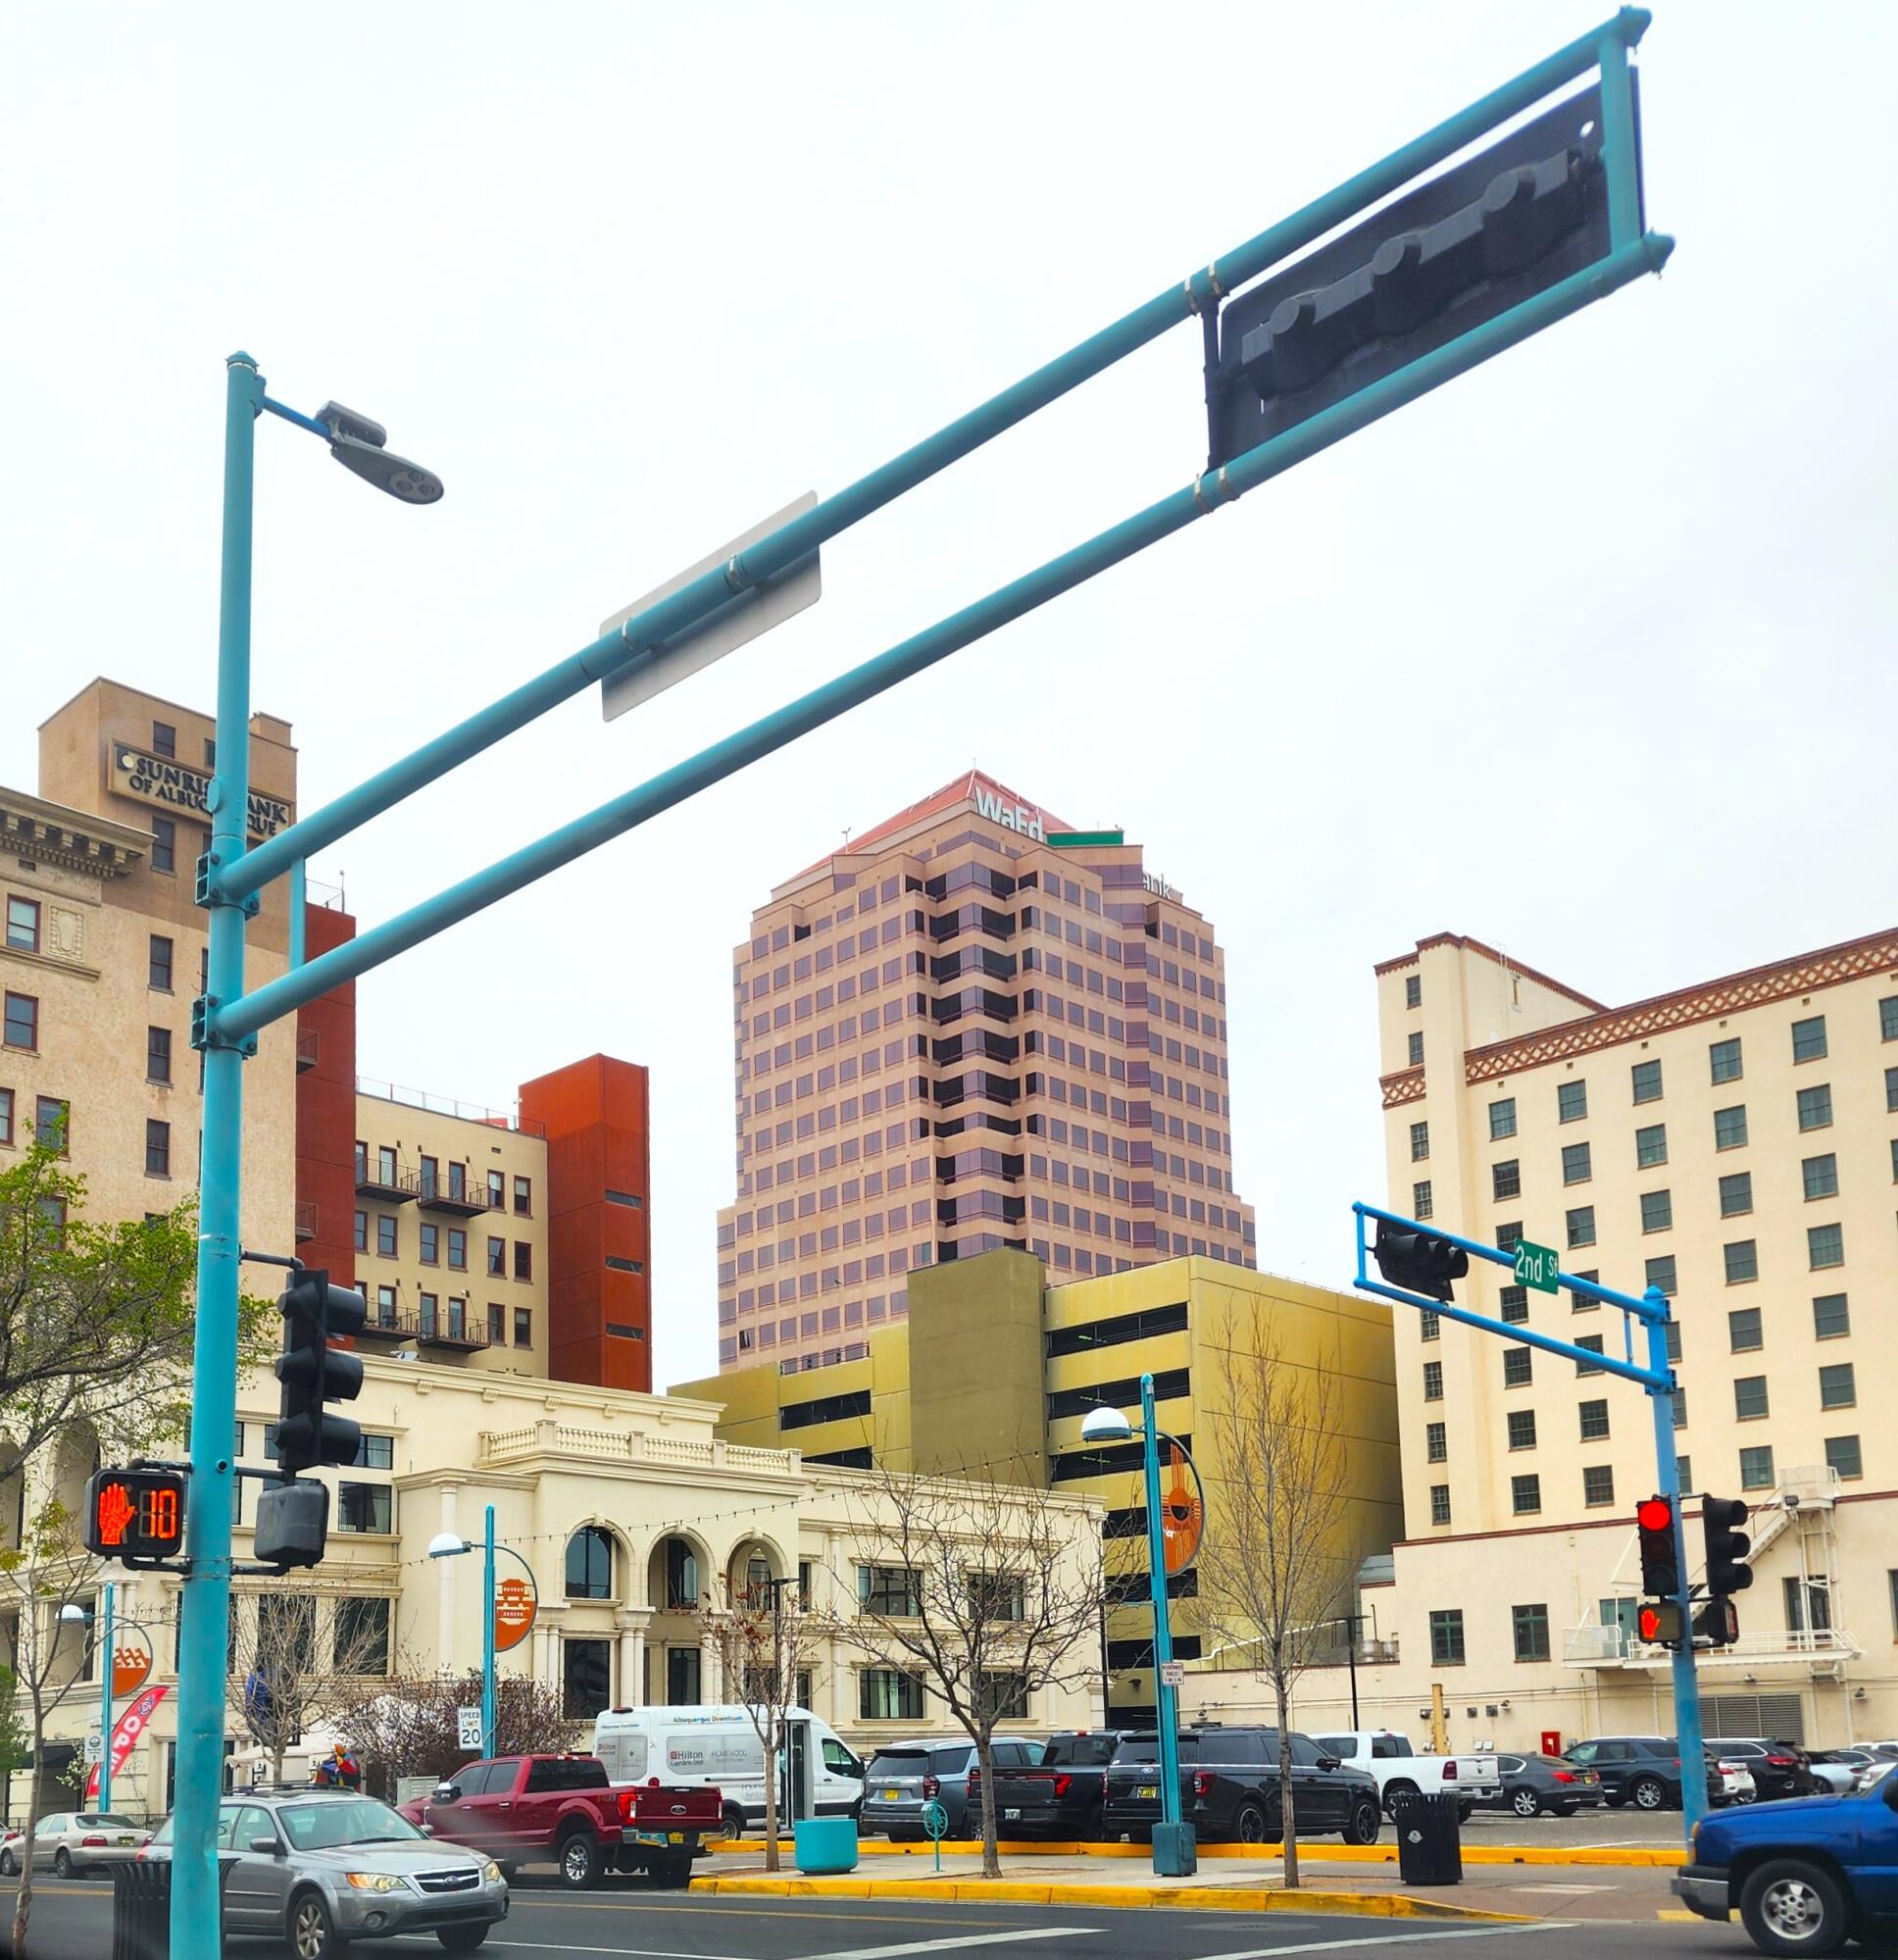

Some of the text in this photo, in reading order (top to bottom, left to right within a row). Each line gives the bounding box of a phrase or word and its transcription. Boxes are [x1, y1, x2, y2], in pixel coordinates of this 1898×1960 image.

[129, 775, 153, 793] OF
[136, 757, 287, 824] SUNRI ANK
[974, 785, 1043, 842] WaFd
[1516, 1245, 1558, 1283] 2nd St
[149, 1489, 176, 1539] 10
[462, 1729, 480, 1744] 20
[670, 1757, 704, 1767] Garden Inn
[677, 1750, 703, 1760] Hilton
